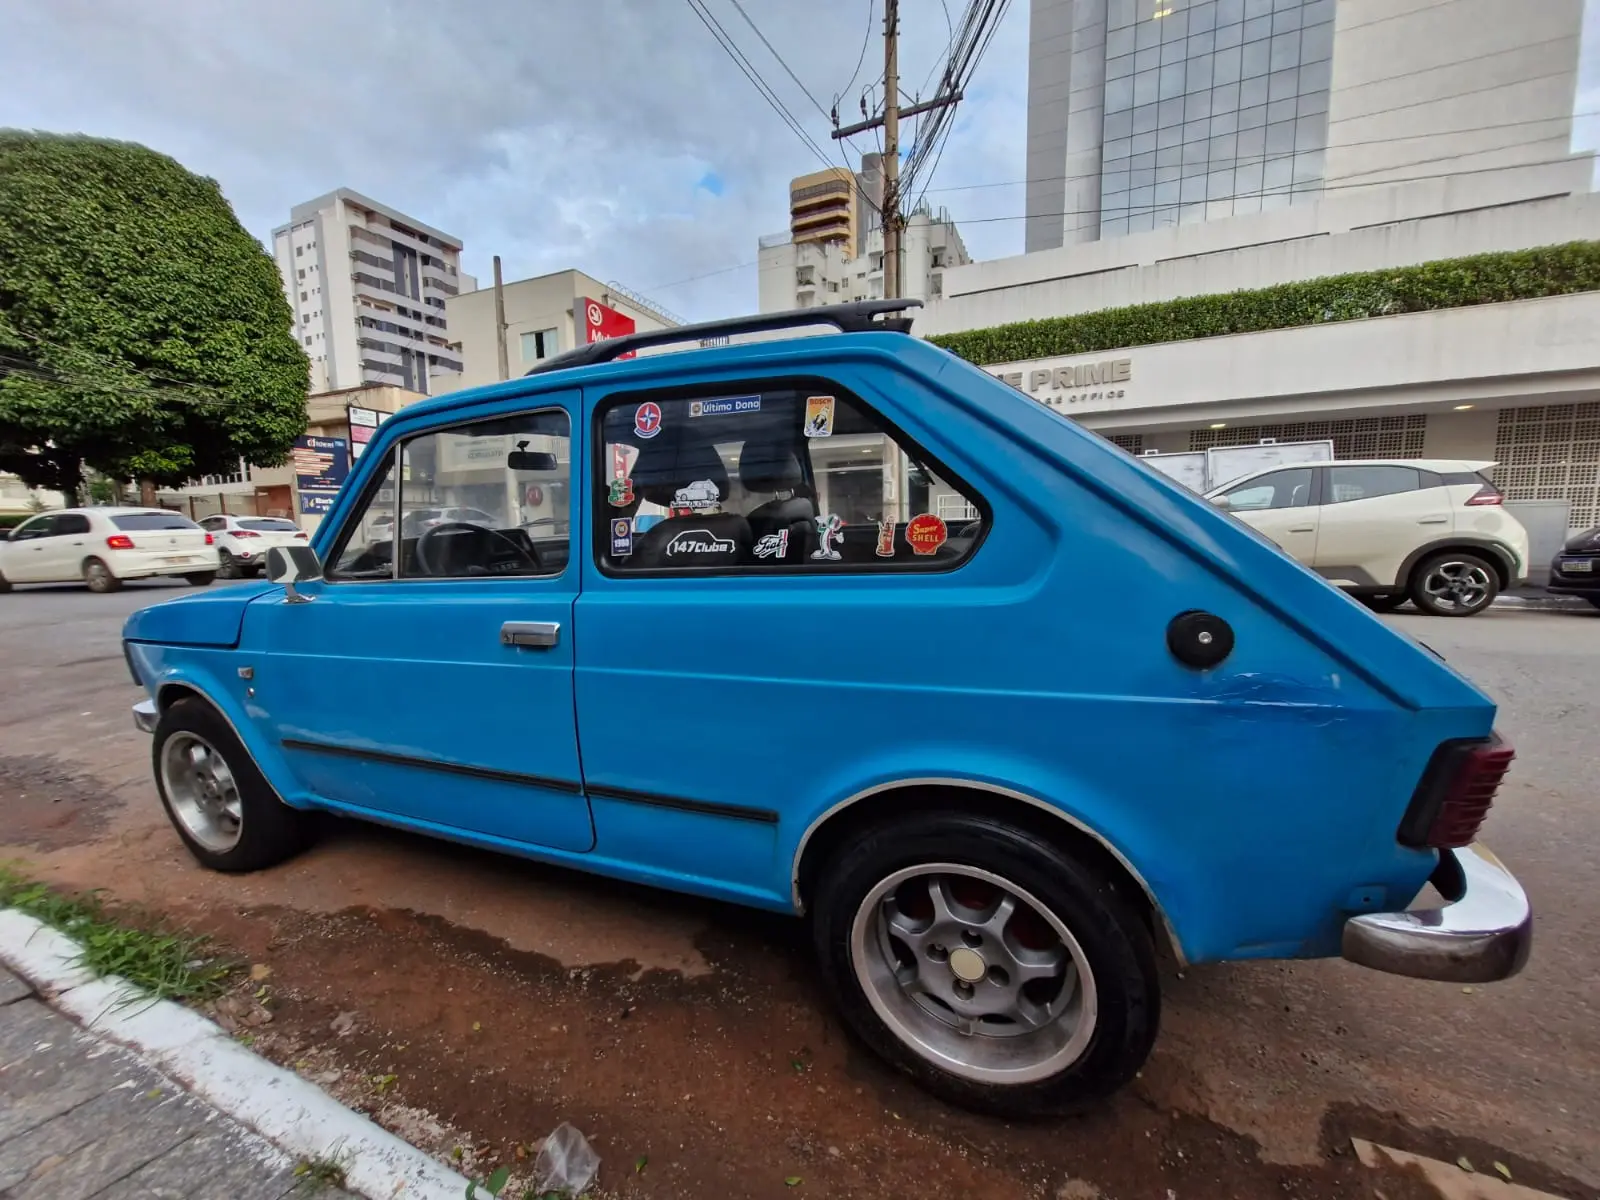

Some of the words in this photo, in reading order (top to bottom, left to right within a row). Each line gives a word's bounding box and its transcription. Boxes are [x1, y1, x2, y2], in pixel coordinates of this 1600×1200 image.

[1030, 358, 1131, 392] PRIME
[703, 402, 732, 413] Último
[912, 523, 938, 535] Super
[912, 534, 939, 543] SHELL
